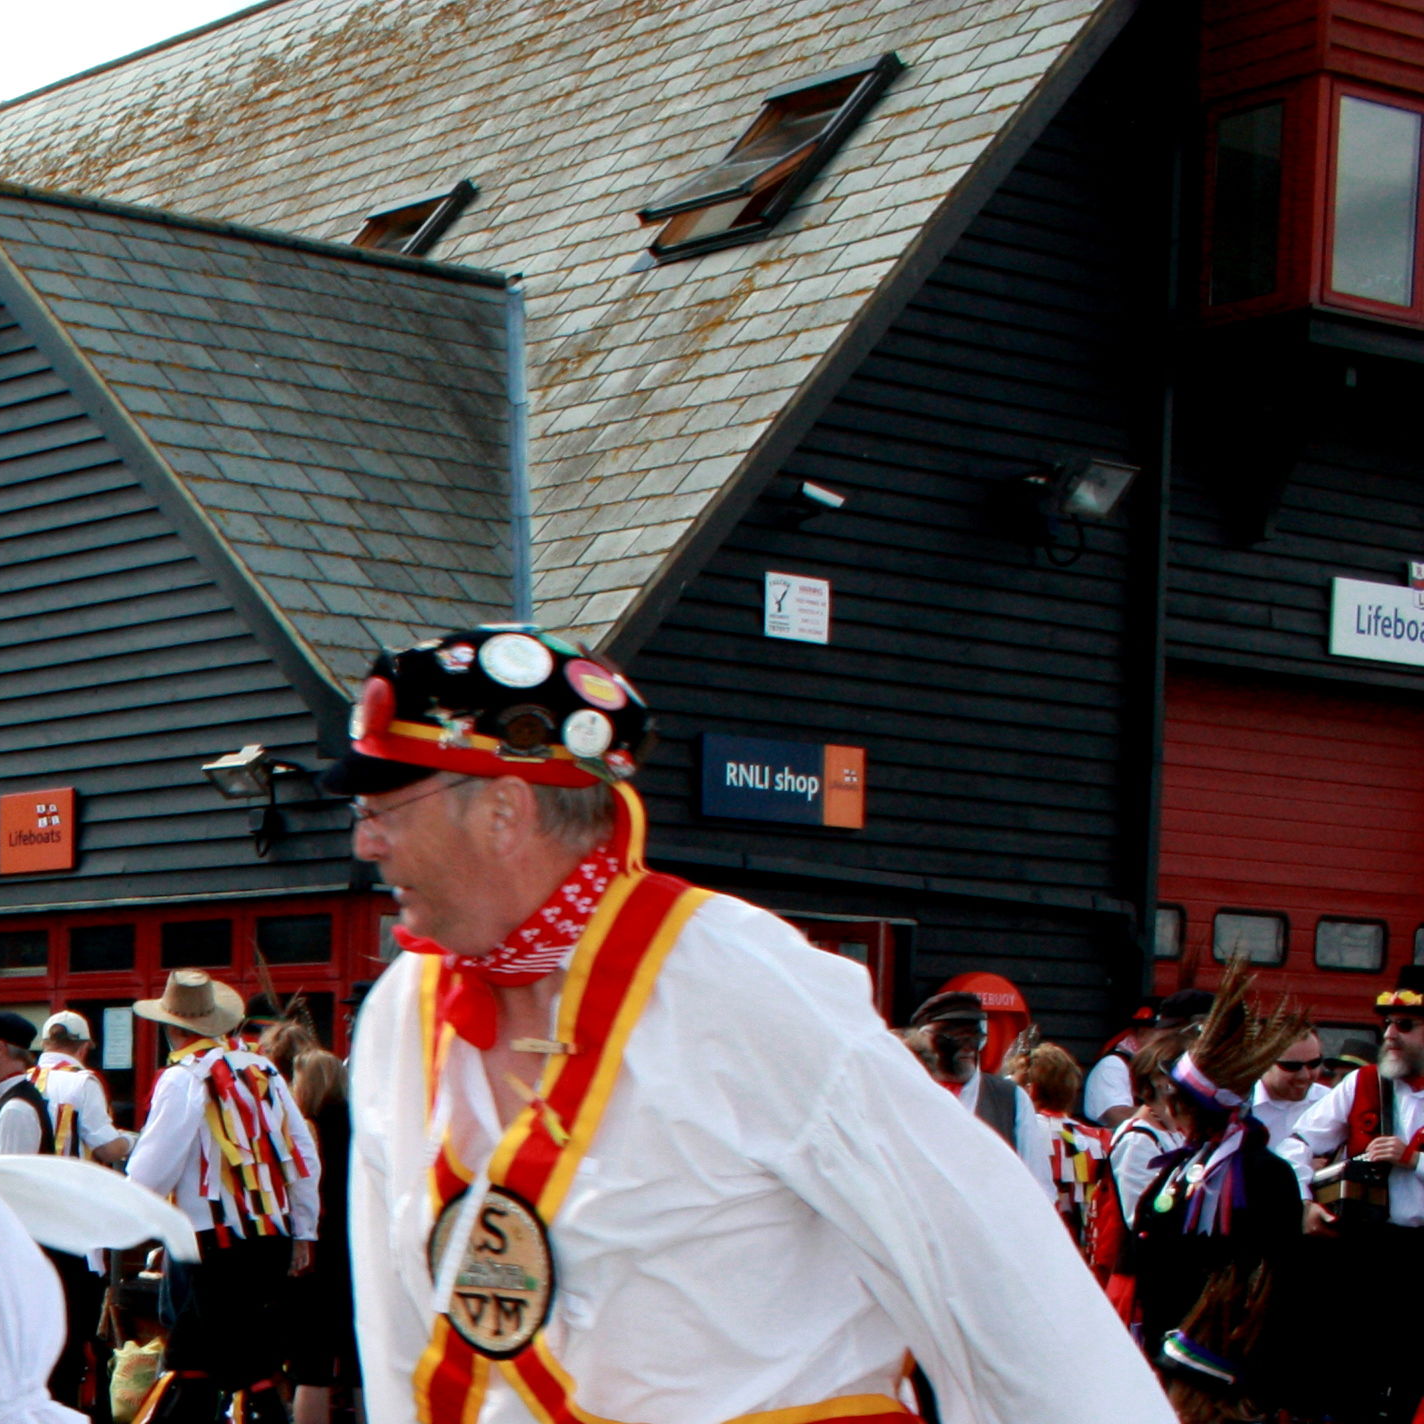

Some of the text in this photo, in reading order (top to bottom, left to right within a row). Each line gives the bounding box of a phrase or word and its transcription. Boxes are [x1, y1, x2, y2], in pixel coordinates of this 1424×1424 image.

[726, 762, 769, 790] RNLI
[775, 766, 820, 801] shop
[8, 829, 62, 847] Lifeboats
[476, 1207, 509, 1255] S
